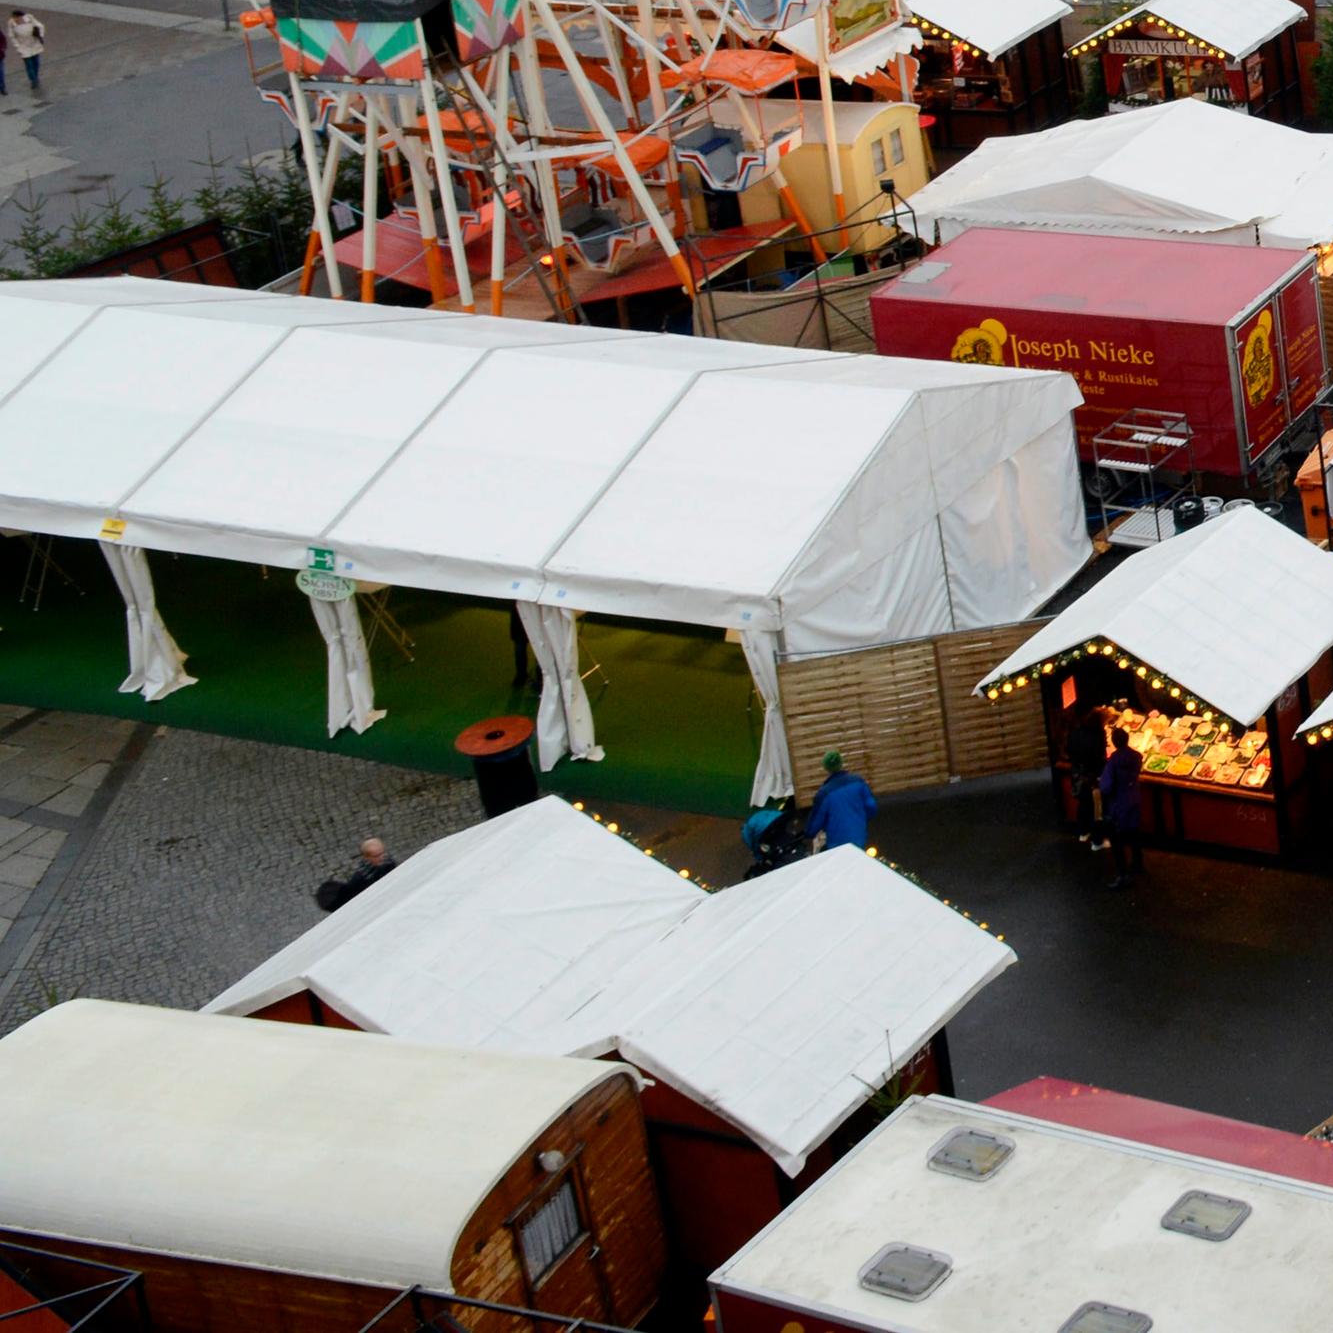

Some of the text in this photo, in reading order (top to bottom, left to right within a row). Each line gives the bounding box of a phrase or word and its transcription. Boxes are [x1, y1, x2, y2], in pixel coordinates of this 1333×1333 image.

[1009, 334, 1155, 368] Joseph Nieke
[1098, 370, 1159, 388] Rustikales
